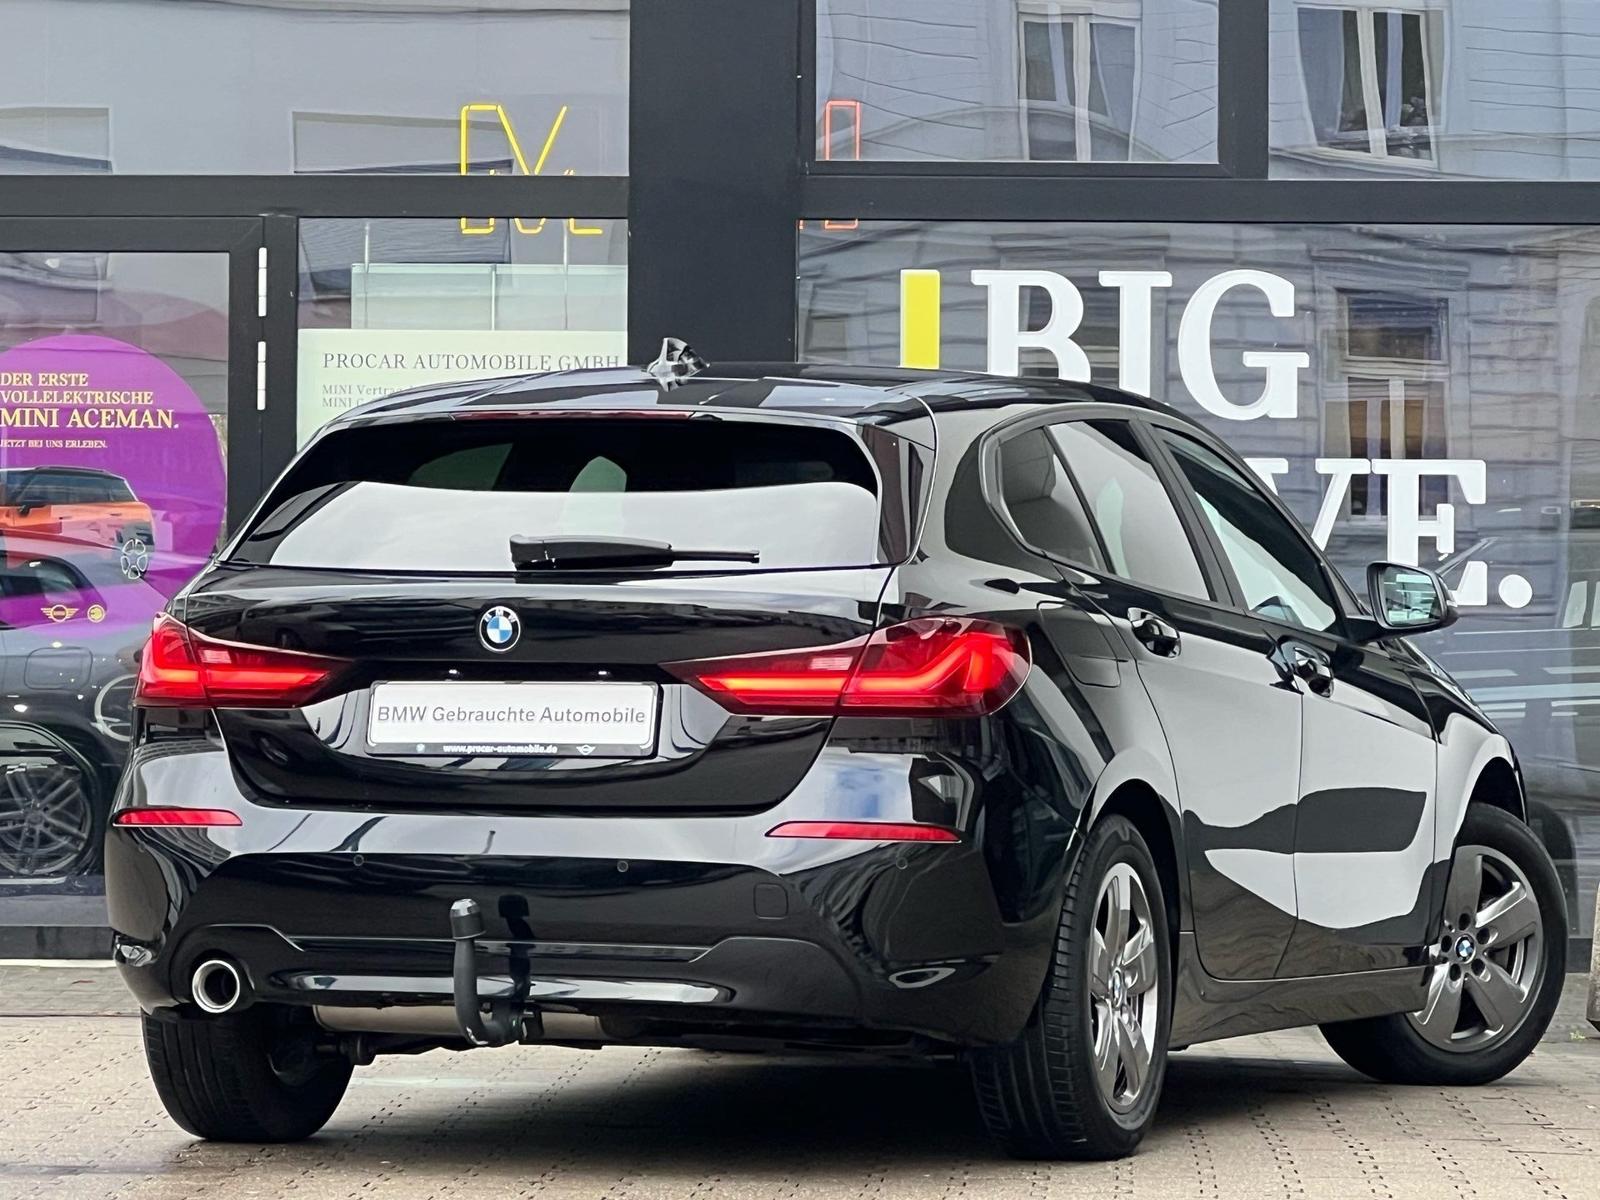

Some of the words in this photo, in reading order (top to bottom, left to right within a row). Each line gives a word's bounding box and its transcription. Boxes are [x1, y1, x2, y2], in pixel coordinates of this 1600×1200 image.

[970, 269, 1310, 421] BIG
[323, 353, 407, 370] PROCAR
[412, 354, 552, 371] AUTOMOBILE
[558, 355, 619, 370] GMBH
[0, 372, 33, 387] DER
[38, 373, 89, 387] ERSTE
[322, 384, 352, 395] MINI
[0, 390, 154, 405] VOLLELEKTRISCHE
[322, 397, 352, 408] MINI
[0, 407, 59, 428] MINI
[66, 409, 179, 429] ACEMAN.
[378, 705, 427, 721] BMW
[432, 705, 536, 722] Gebrauchte
[539, 706, 646, 723] Automobile
[443, 744, 559, 755] www.procar-automobile.de
